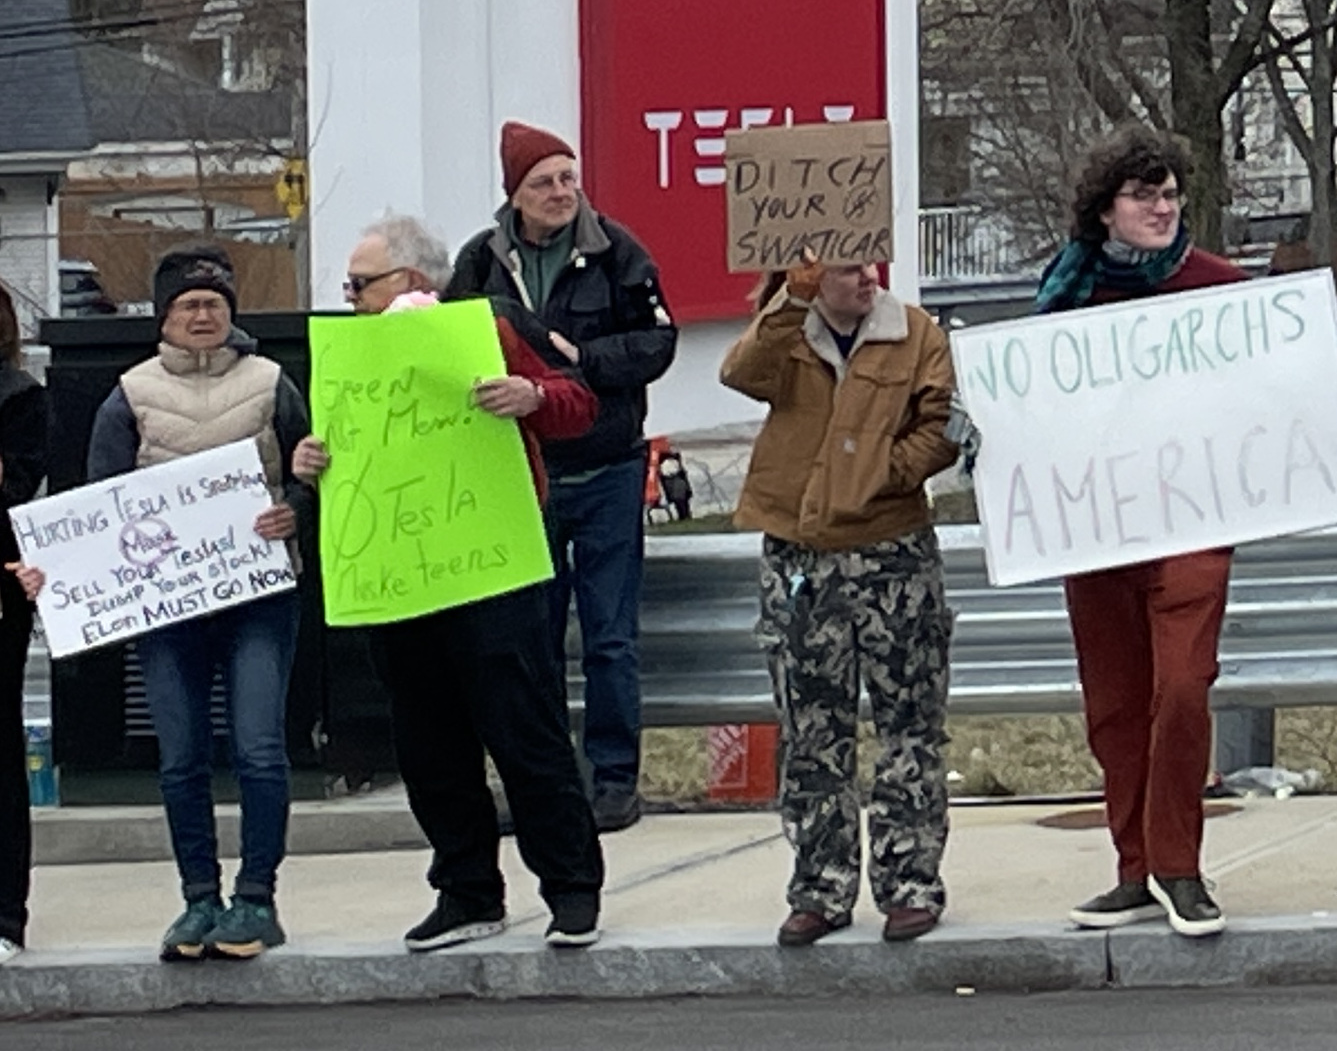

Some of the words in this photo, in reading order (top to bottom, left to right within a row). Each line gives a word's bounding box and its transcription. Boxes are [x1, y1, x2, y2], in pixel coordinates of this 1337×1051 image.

[735, 155, 885, 195] DITCH
[752, 194, 826, 227] YOUR
[967, 336, 1031, 401] NO
[1050, 289, 1305, 393] OLIGARCHS
[1005, 419, 1336, 556] AMERICA
[143, 587, 207, 626] MUST
[213, 578, 243, 601] GO
